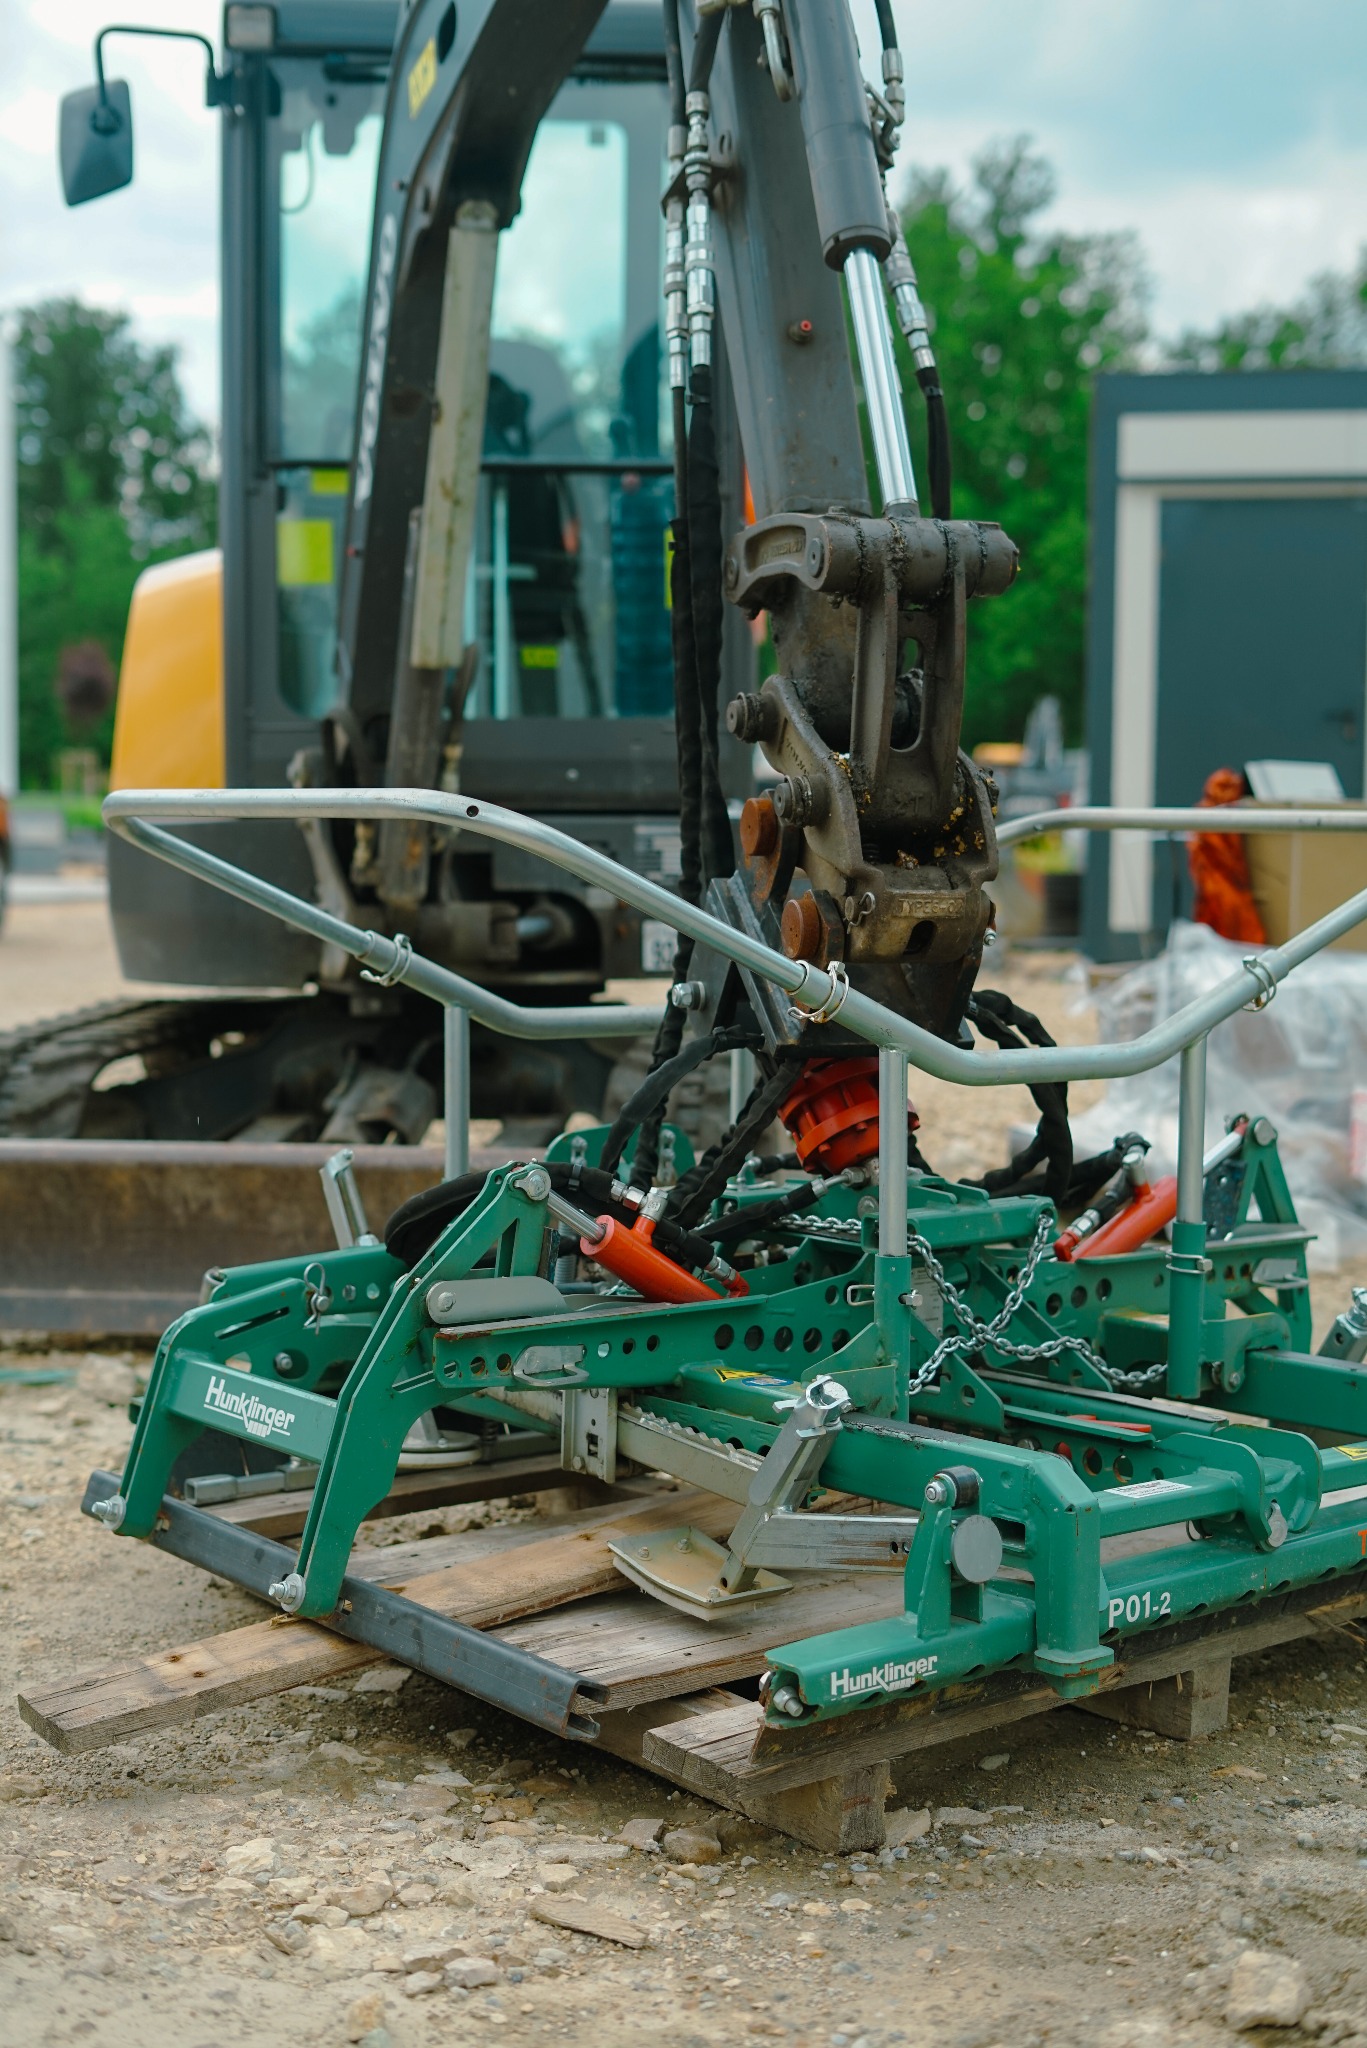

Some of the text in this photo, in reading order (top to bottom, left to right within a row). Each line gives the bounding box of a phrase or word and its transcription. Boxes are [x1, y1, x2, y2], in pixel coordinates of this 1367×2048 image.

[205, 1375, 295, 1437] Hunklinger
[1108, 1591, 1171, 1628] P01-2
[830, 1655, 938, 1693] Hunklinger
